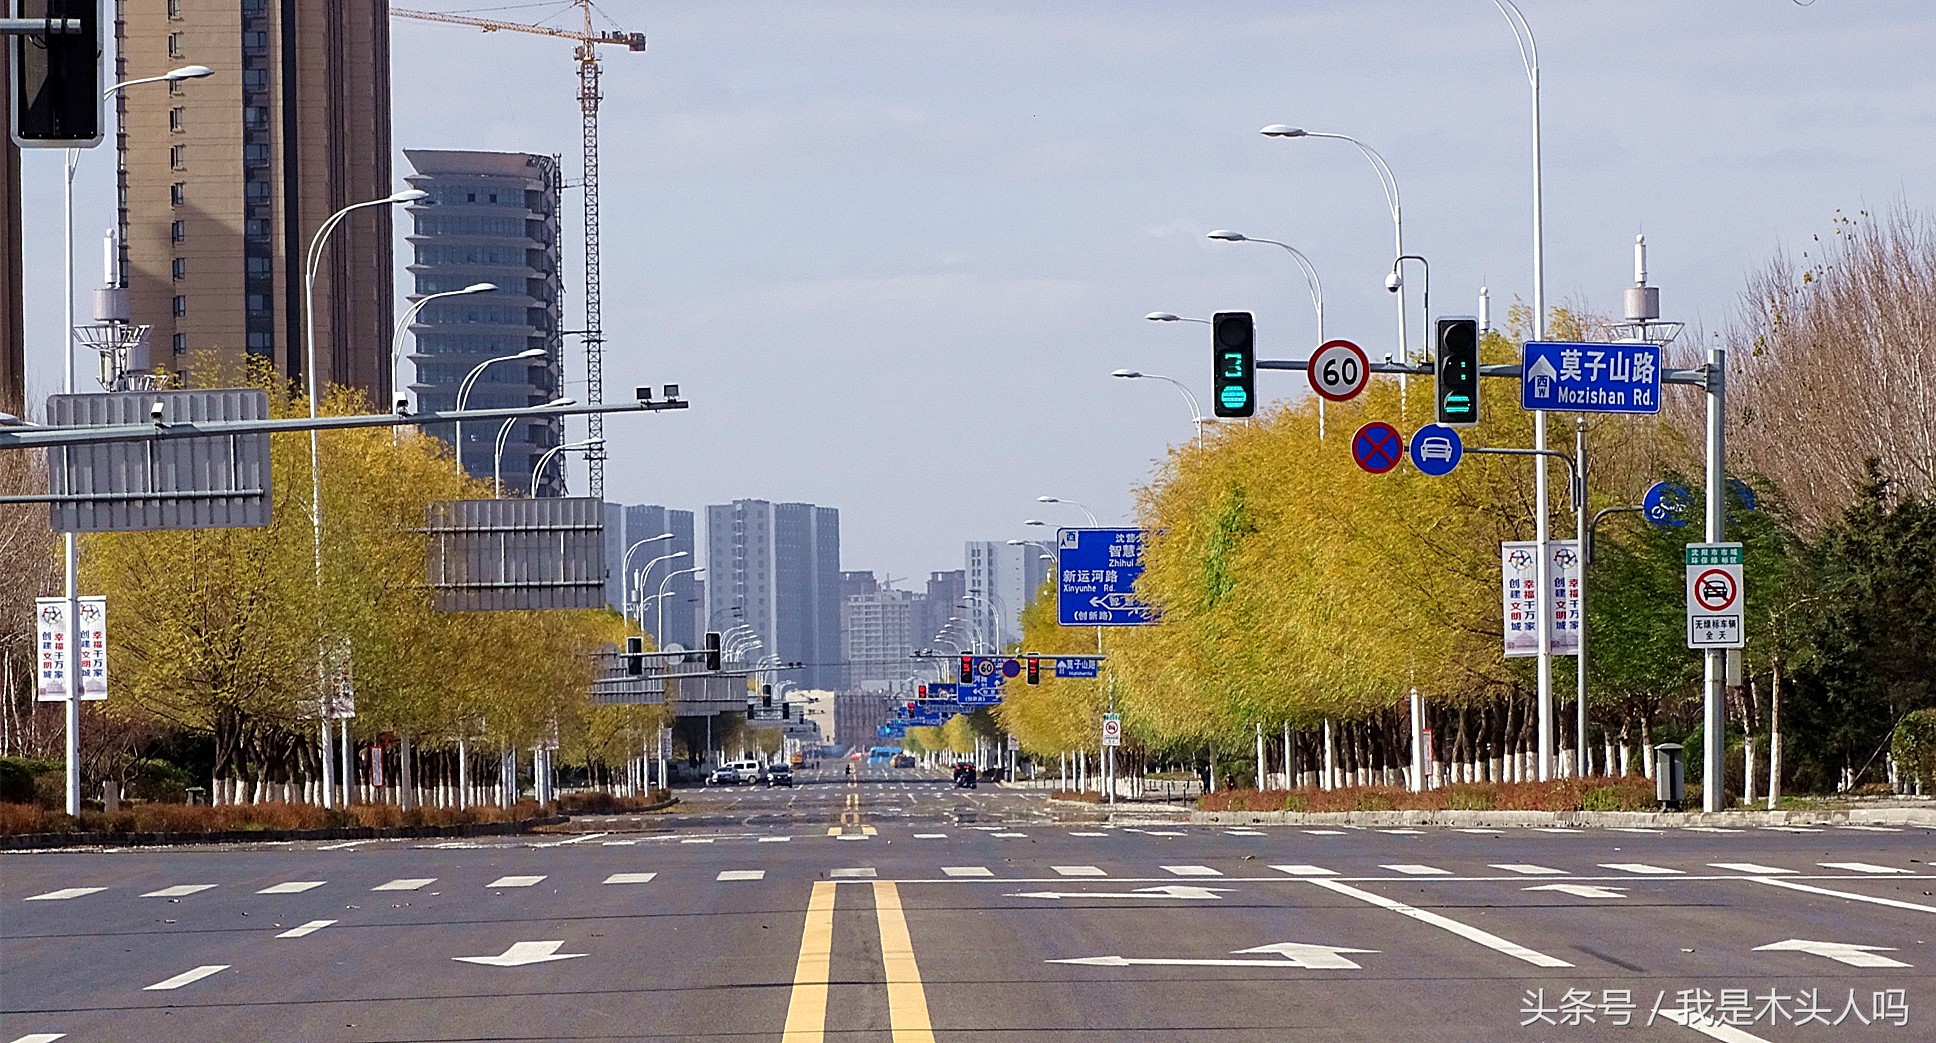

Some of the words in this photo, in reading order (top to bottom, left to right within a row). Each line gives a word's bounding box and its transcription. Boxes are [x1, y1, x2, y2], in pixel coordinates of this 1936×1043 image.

[1225, 353, 1242, 377] 3
[1323, 358, 1358, 386] 60
[1560, 349, 1656, 384] 莫子山路
[1558, 386, 1625, 405] Mozishan
[1633, 388, 1654, 406] Rd.
[1063, 569, 1118, 583] 新运河路
[1108, 559, 1134, 567] Zhihui
[1063, 584, 1096, 594] Xinyunhe
[1103, 584, 1116, 592] Rd.
[1509, 579, 1521, 631] 创建文明城
[1523, 579, 1535, 631] 幸福千万家
[1554, 577, 1566, 630] 创建文明城
[1695, 620, 1736, 630] 无绿标车辆
[42, 631, 52, 679] 创建文明城
[54, 632, 64, 679] 幸福千万家
[93, 630, 103, 677] 幸福千万家
[980, 663, 993, 673] 60
